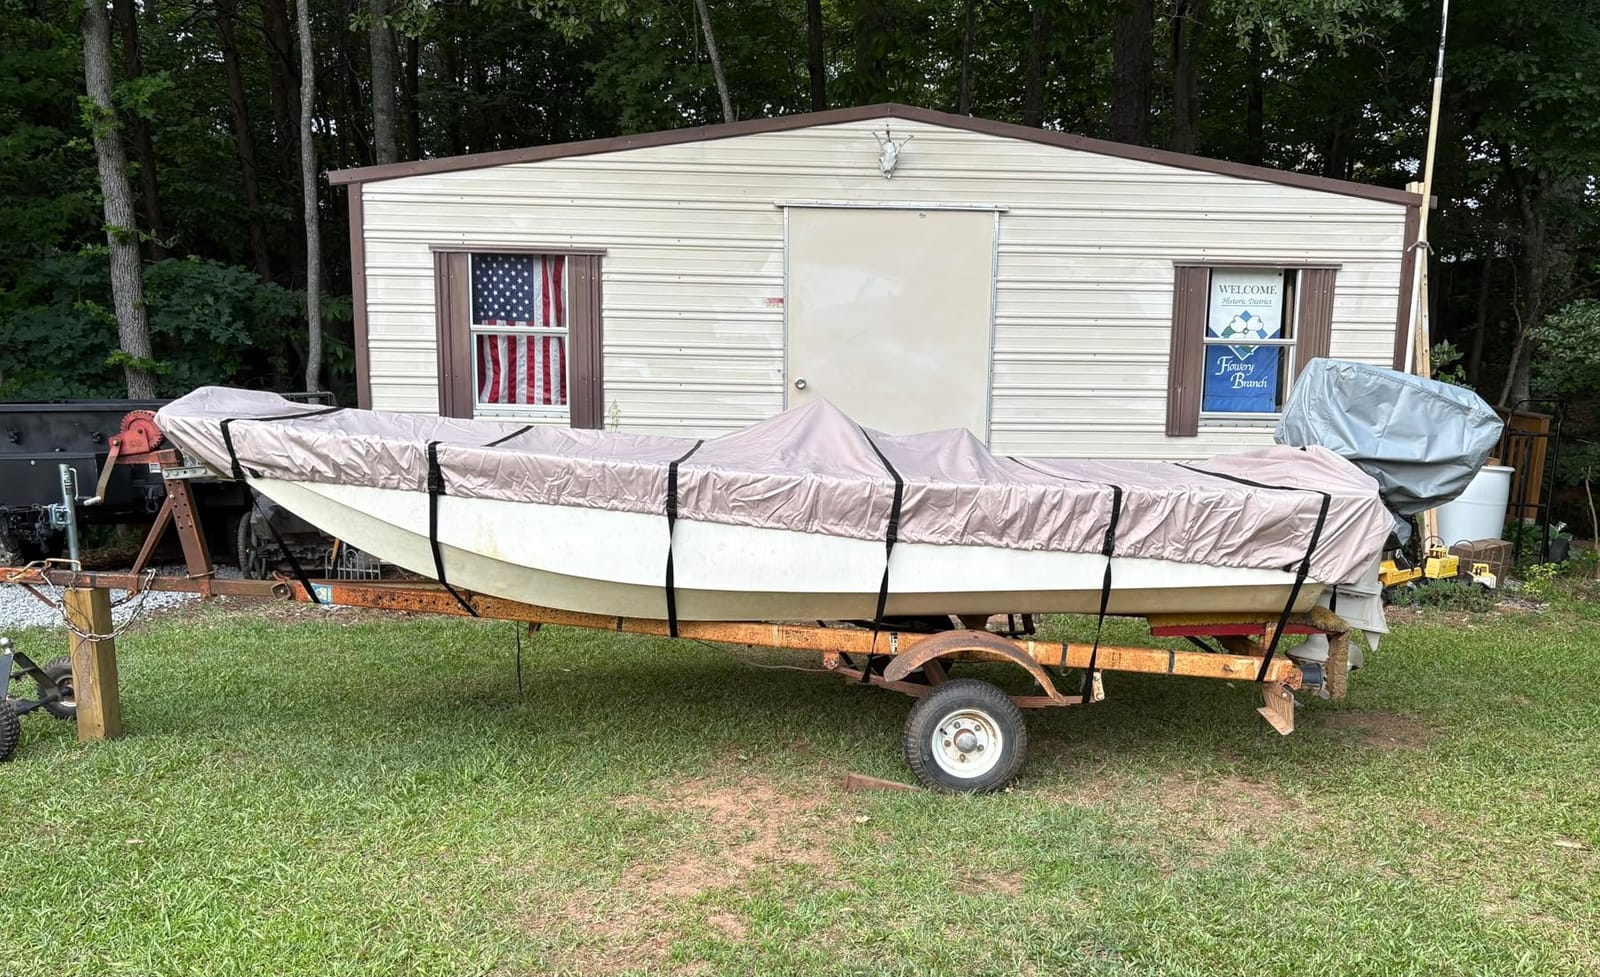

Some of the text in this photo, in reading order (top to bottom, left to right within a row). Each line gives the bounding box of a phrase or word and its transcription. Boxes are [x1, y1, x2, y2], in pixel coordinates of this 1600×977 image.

[1219, 284, 1277, 295] WELCOME
[1222, 296, 1272, 305] Historic District
[1215, 356, 1254, 376] Flowery
[1231, 372, 1268, 389] Branch
